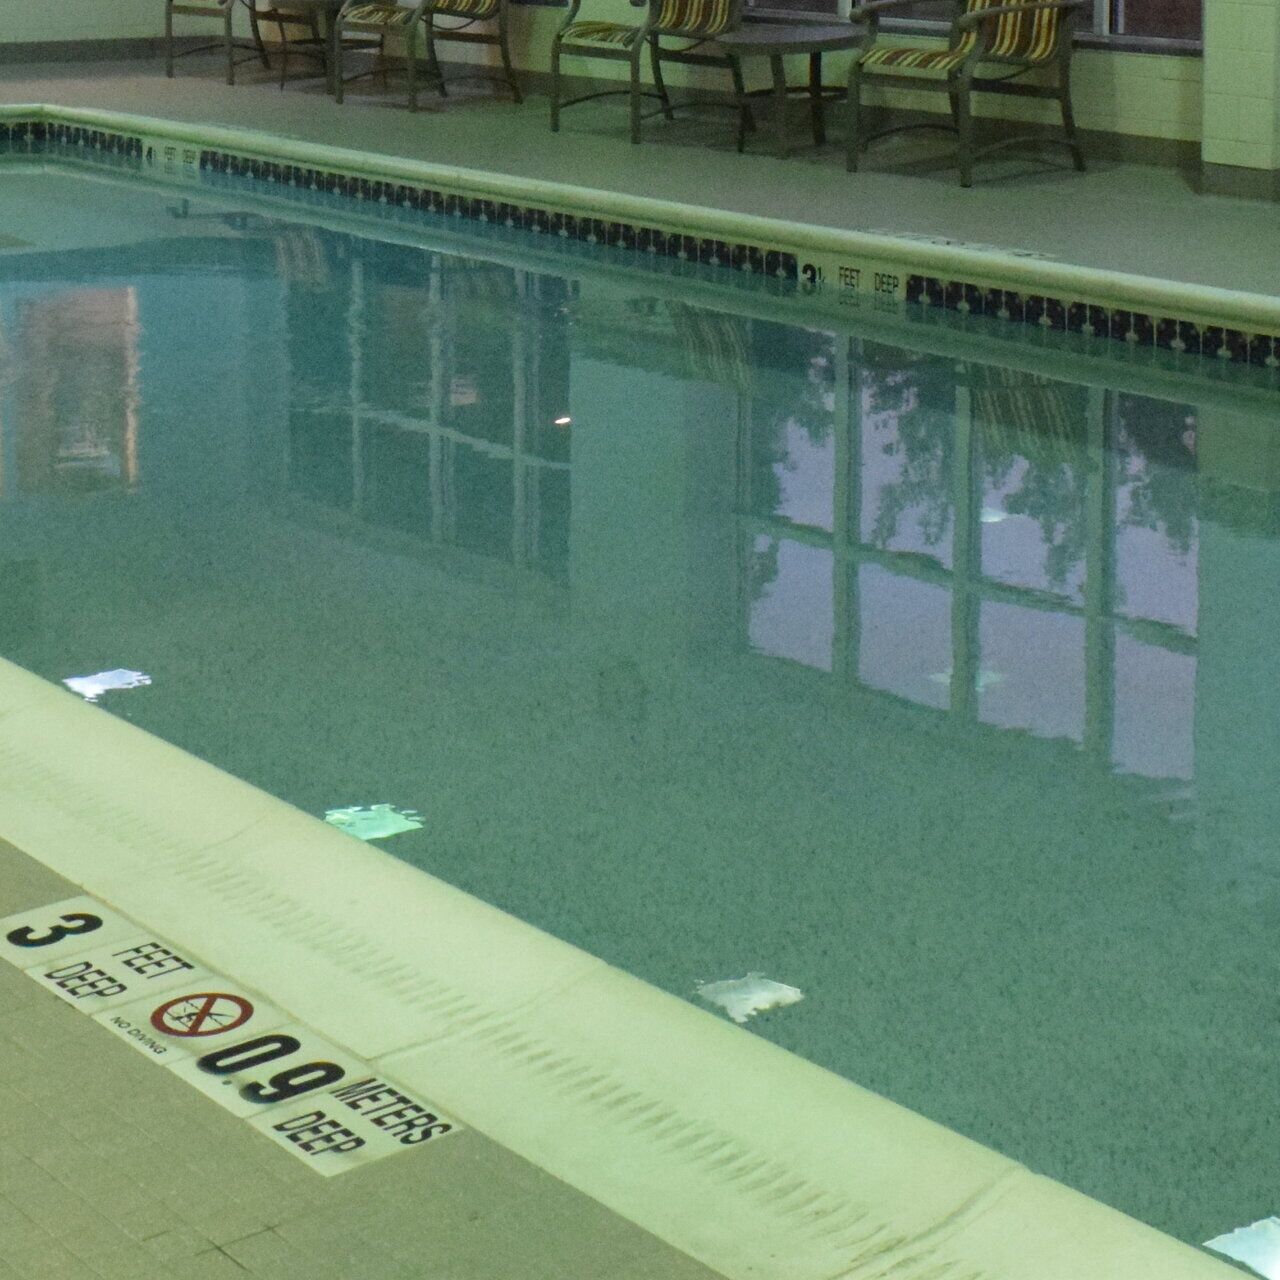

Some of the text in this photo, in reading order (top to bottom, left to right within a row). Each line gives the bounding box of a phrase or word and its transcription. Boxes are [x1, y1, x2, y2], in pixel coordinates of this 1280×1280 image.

[838, 266, 861, 288] FEET
[875, 271, 899, 295] DEEP
[6, 912, 103, 949] 3
[44, 960, 128, 1003] DEEP
[113, 941, 196, 981] FEET
[112, 1015, 168, 1056] NO DIVING
[330, 1077, 453, 1145] METERS
[272, 1109, 366, 1157] DEEP
